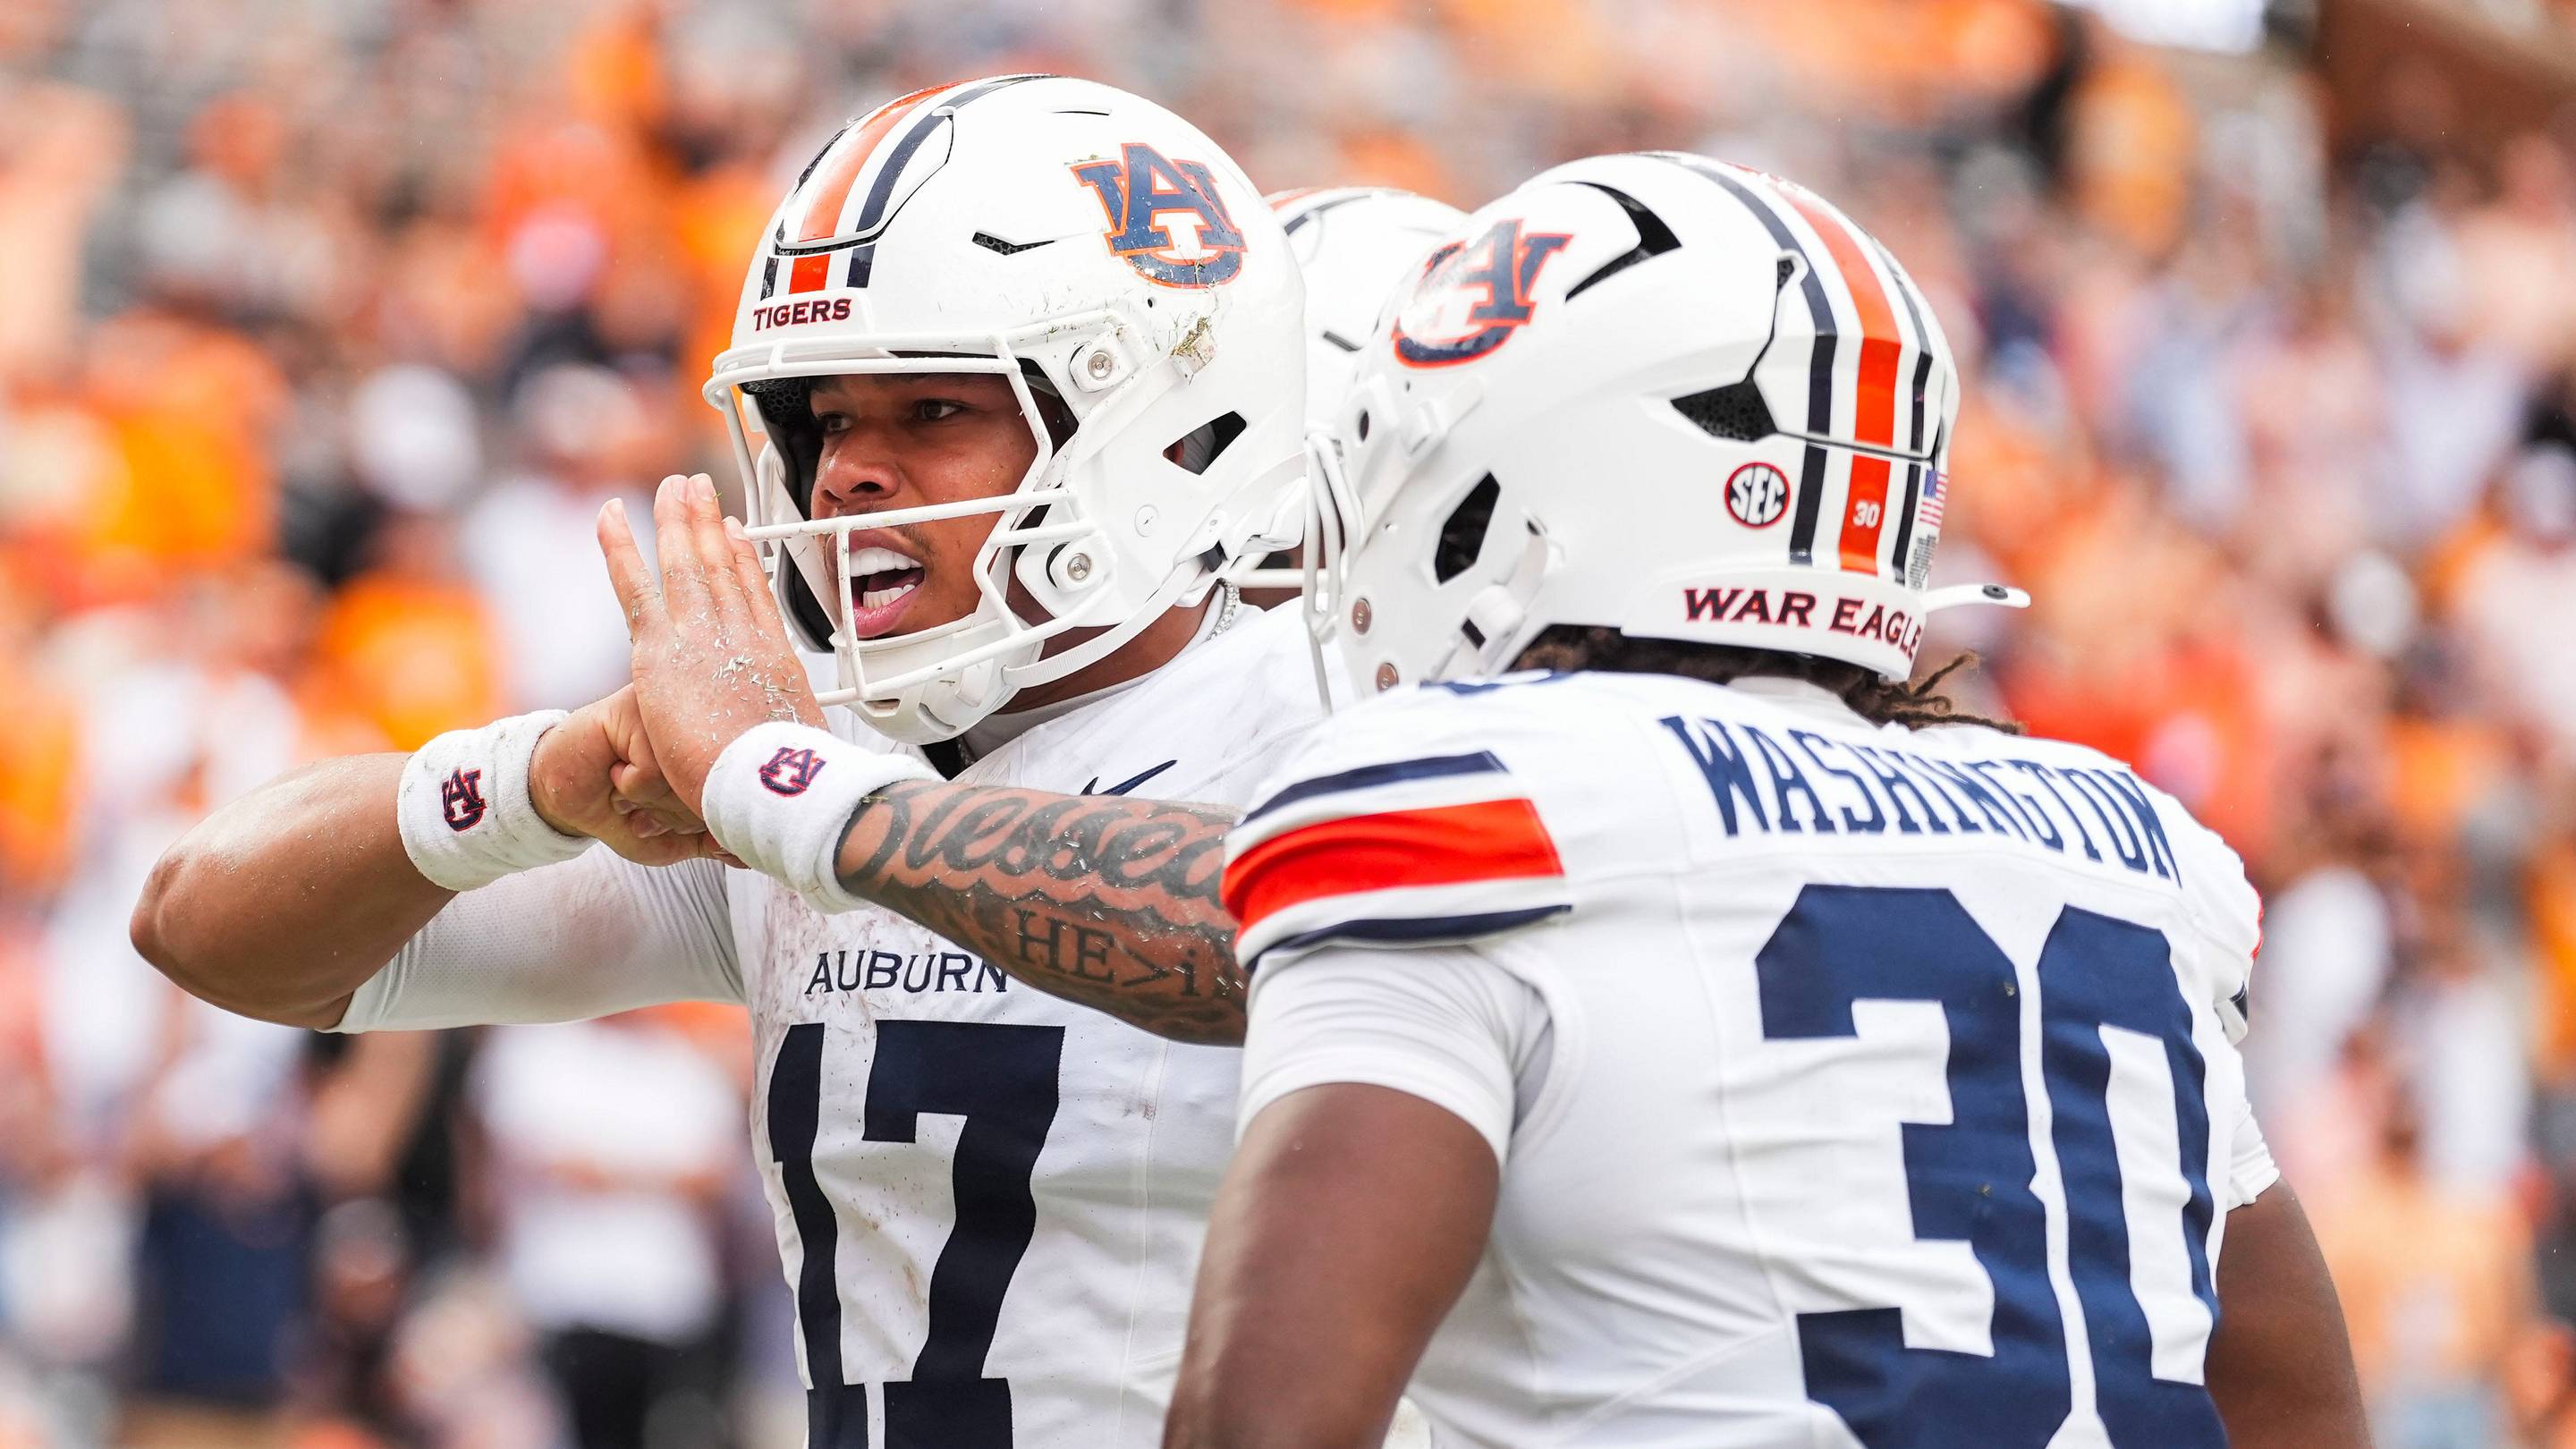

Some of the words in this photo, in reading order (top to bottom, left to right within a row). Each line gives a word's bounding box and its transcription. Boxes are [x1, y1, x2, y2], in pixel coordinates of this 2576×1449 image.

[753, 298, 852, 332] TIGERS
[1729, 464, 1786, 524] SEC
[1852, 499, 1880, 529] 30
[1683, 587, 1818, 628] WAR
[1828, 596, 1922, 663] EAGLE
[1659, 715, 2182, 889] WASHINGTON
[804, 950, 1008, 995] AUBURN
[1755, 883, 2229, 1449] 30
[767, 1019, 1066, 1449] 17
